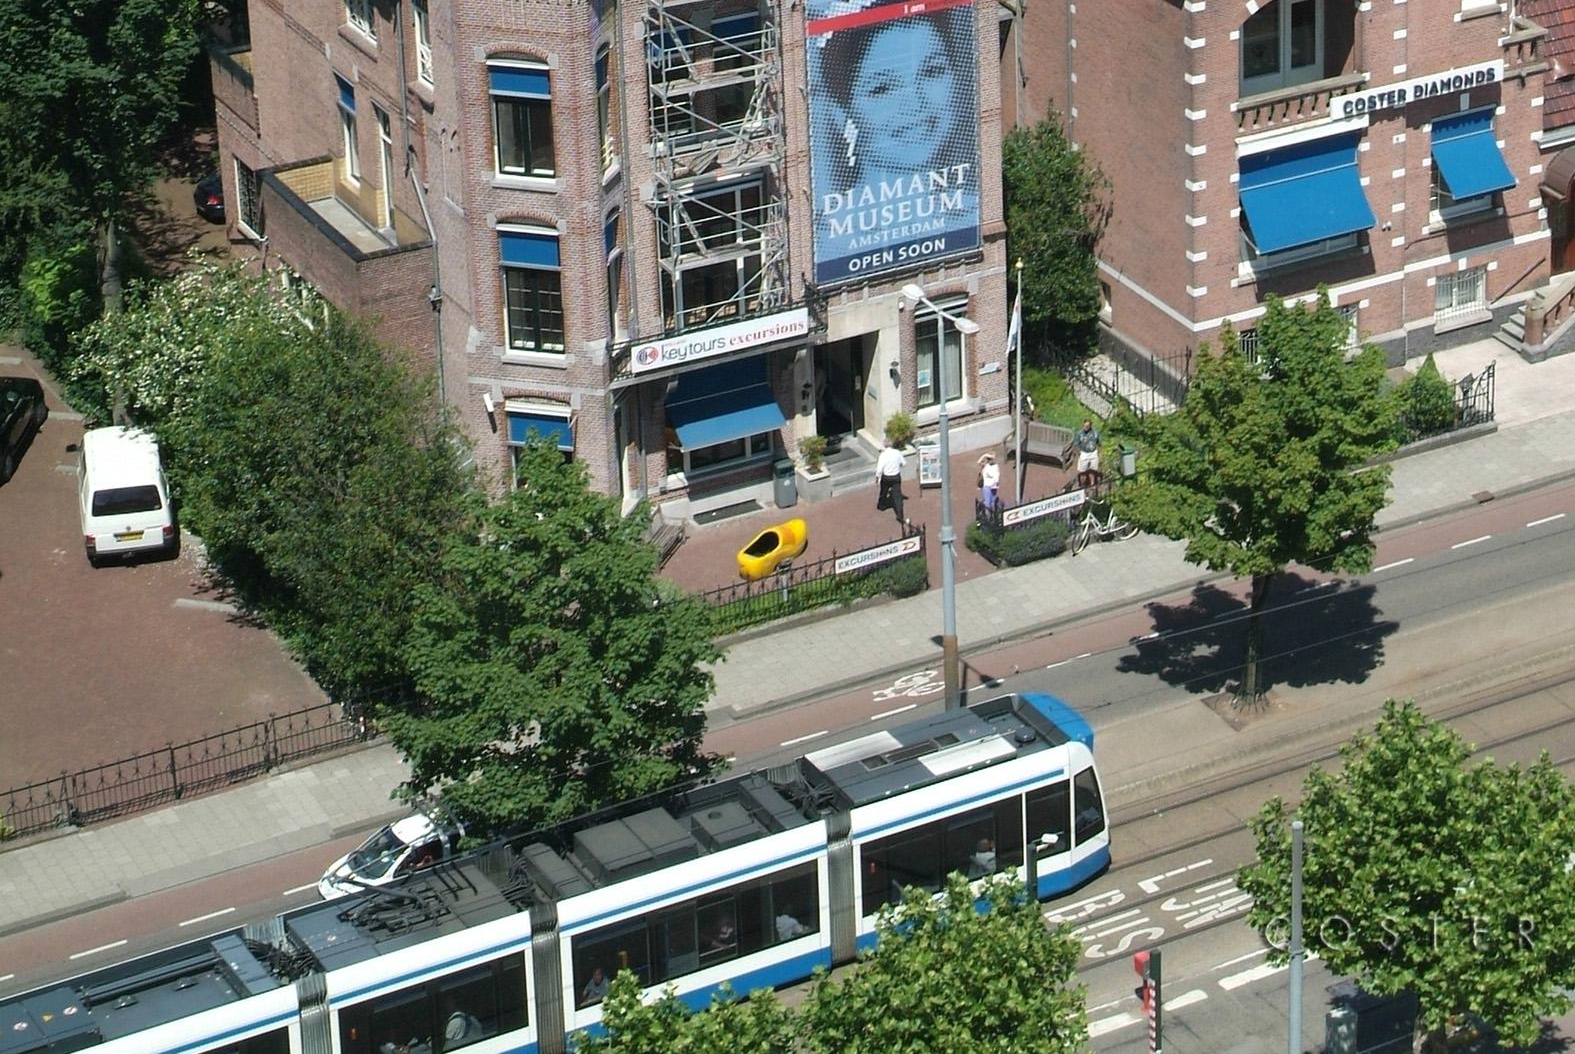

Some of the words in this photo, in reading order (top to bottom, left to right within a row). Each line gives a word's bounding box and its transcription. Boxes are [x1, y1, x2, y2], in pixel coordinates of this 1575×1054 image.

[1342, 88, 1407, 117] COSTER
[1413, 67, 1496, 100] DIAMONDS
[823, 162, 970, 216] DIAMANT
[828, 189, 964, 239] MUSEUM
[848, 248, 894, 272] OPEN
[898, 237, 946, 262] SOON
[849, 217, 946, 250] AMSTERDAM
[729, 320, 805, 346] excursions
[1044, 889, 1166, 959] BUS
